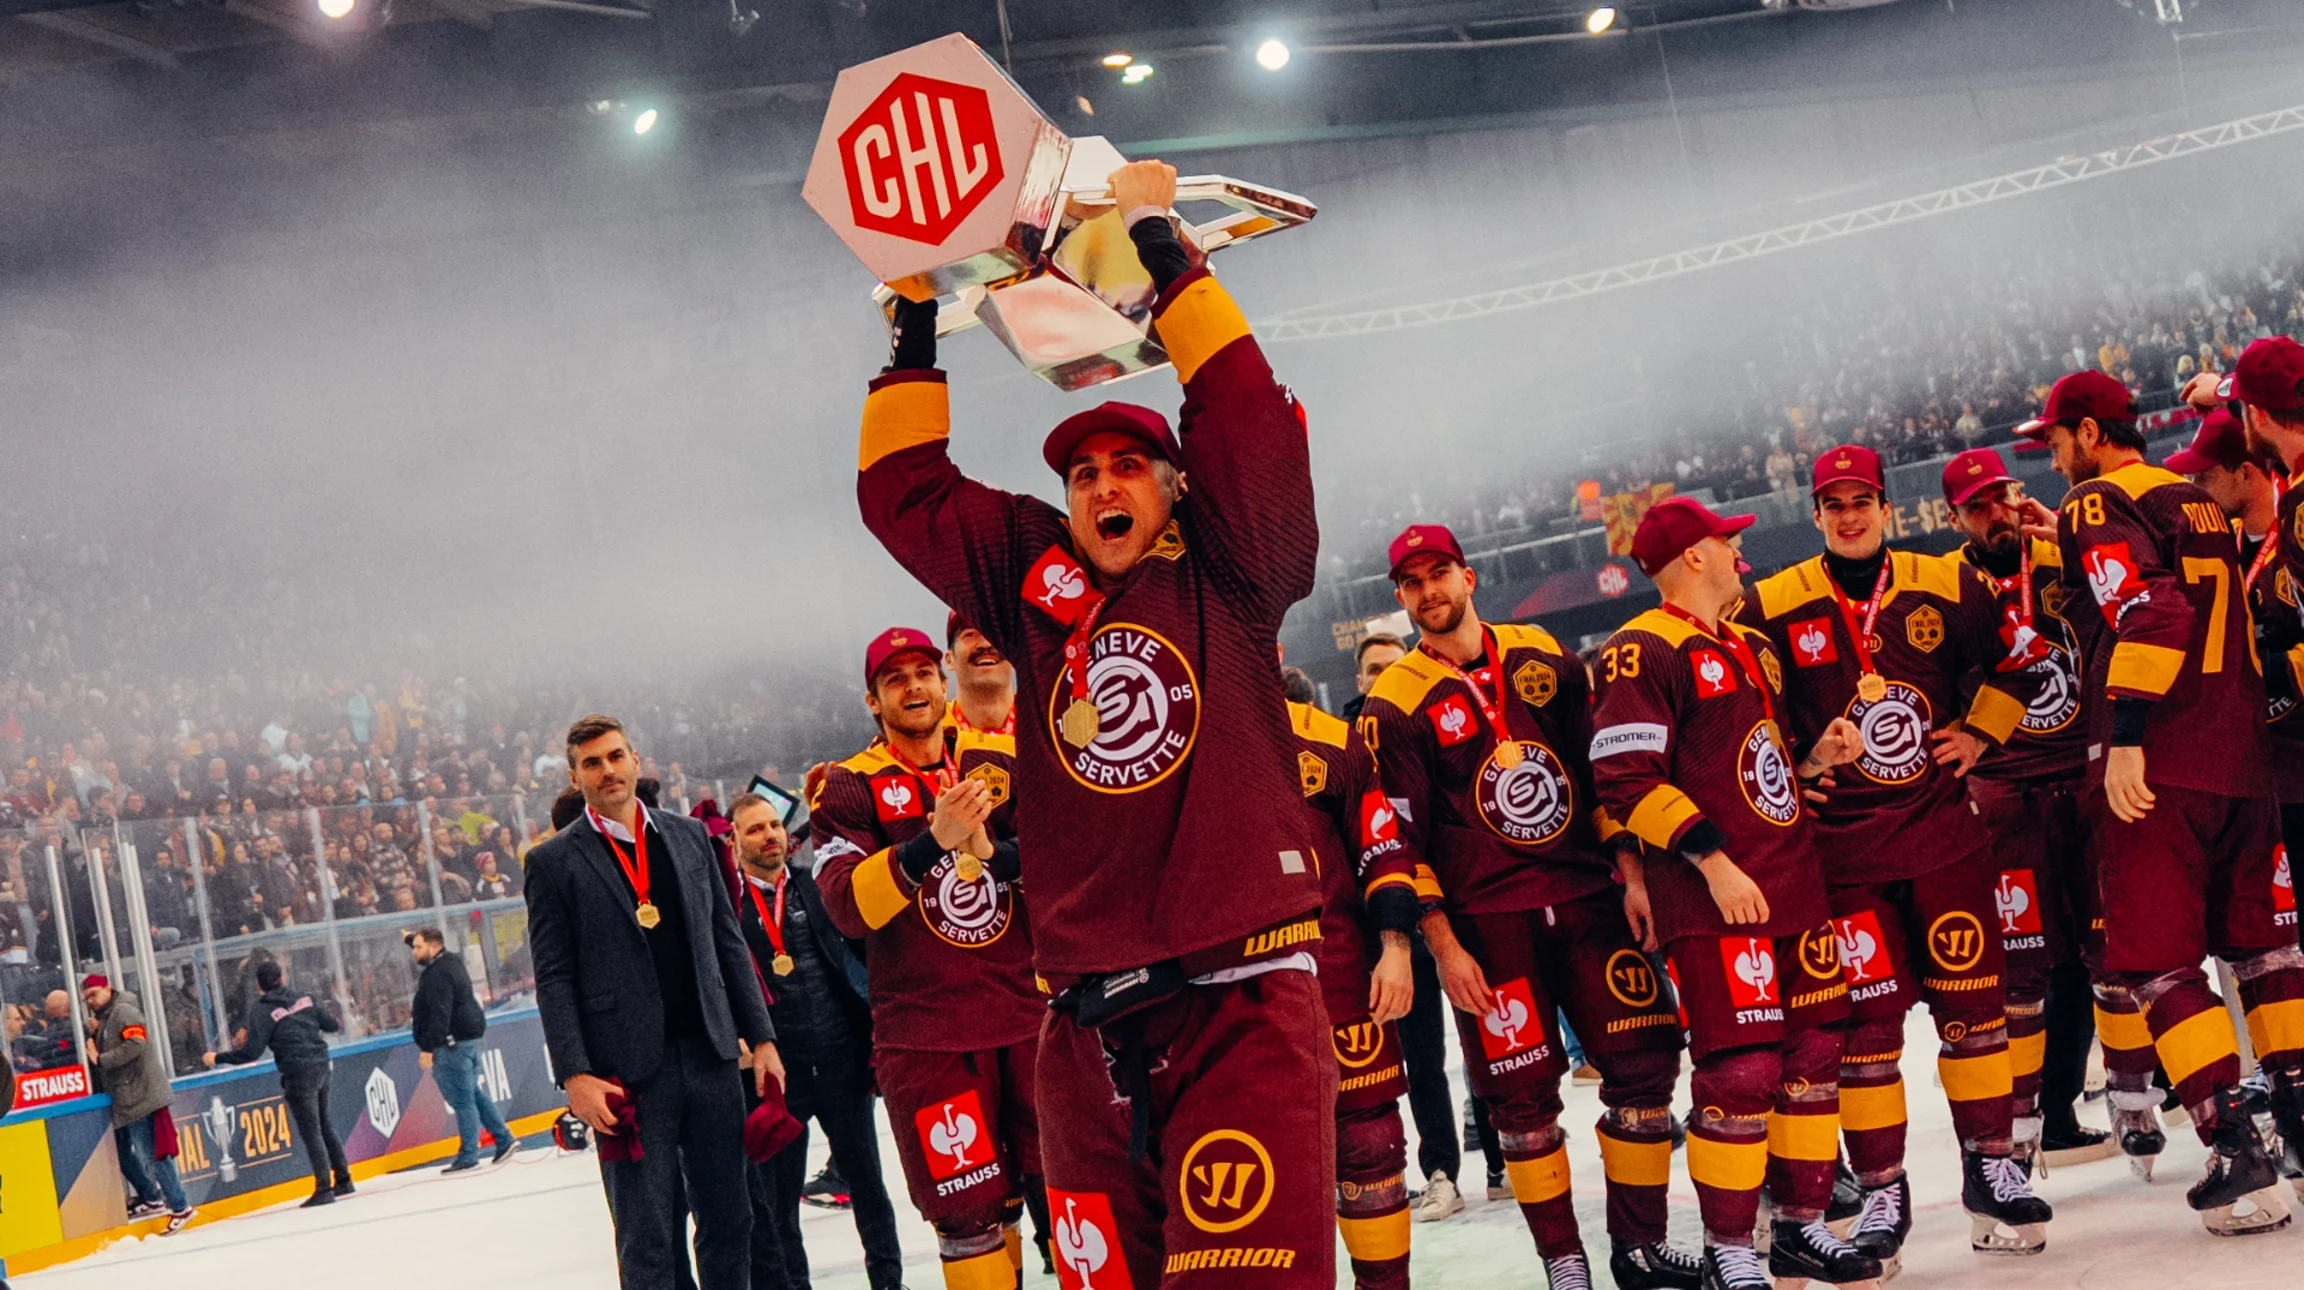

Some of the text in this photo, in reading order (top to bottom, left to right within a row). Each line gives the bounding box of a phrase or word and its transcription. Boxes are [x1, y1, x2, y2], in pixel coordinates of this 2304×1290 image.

[853, 90, 989, 226] CHL
[2065, 493, 2106, 534] 78
[1598, 566, 1627, 594] CHL
[2182, 556, 2229, 674] 7
[1536, 672, 1551, 682] 2024
[1602, 643, 1640, 683] 33
[1170, 684, 1193, 702] 05
[2022, 697, 2076, 728] ERVETTE
[1074, 730, 1187, 785] SERVETTE
[1861, 747, 1928, 779] SERVETTE
[1743, 770, 1755, 782] 19
[1483, 800, 1497, 812] 19
[1501, 802, 1568, 839] SERVETTE
[924, 897, 937, 908] 19
[938, 909, 1007, 942] SERVETTE
[1607, 1013, 1677, 1034] WARRIOR
[1490, 1044, 1550, 1077] STRAUSS
[22, 1071, 85, 1101] STRAUSS
[1338, 1064, 1399, 1092] ARRIOR
[368, 1075, 397, 1128] CHL
[240, 1103, 292, 1158] 2024
[937, 1162, 1001, 1197] STRAUSS
[1165, 1247, 1296, 1274] WARRIOR
